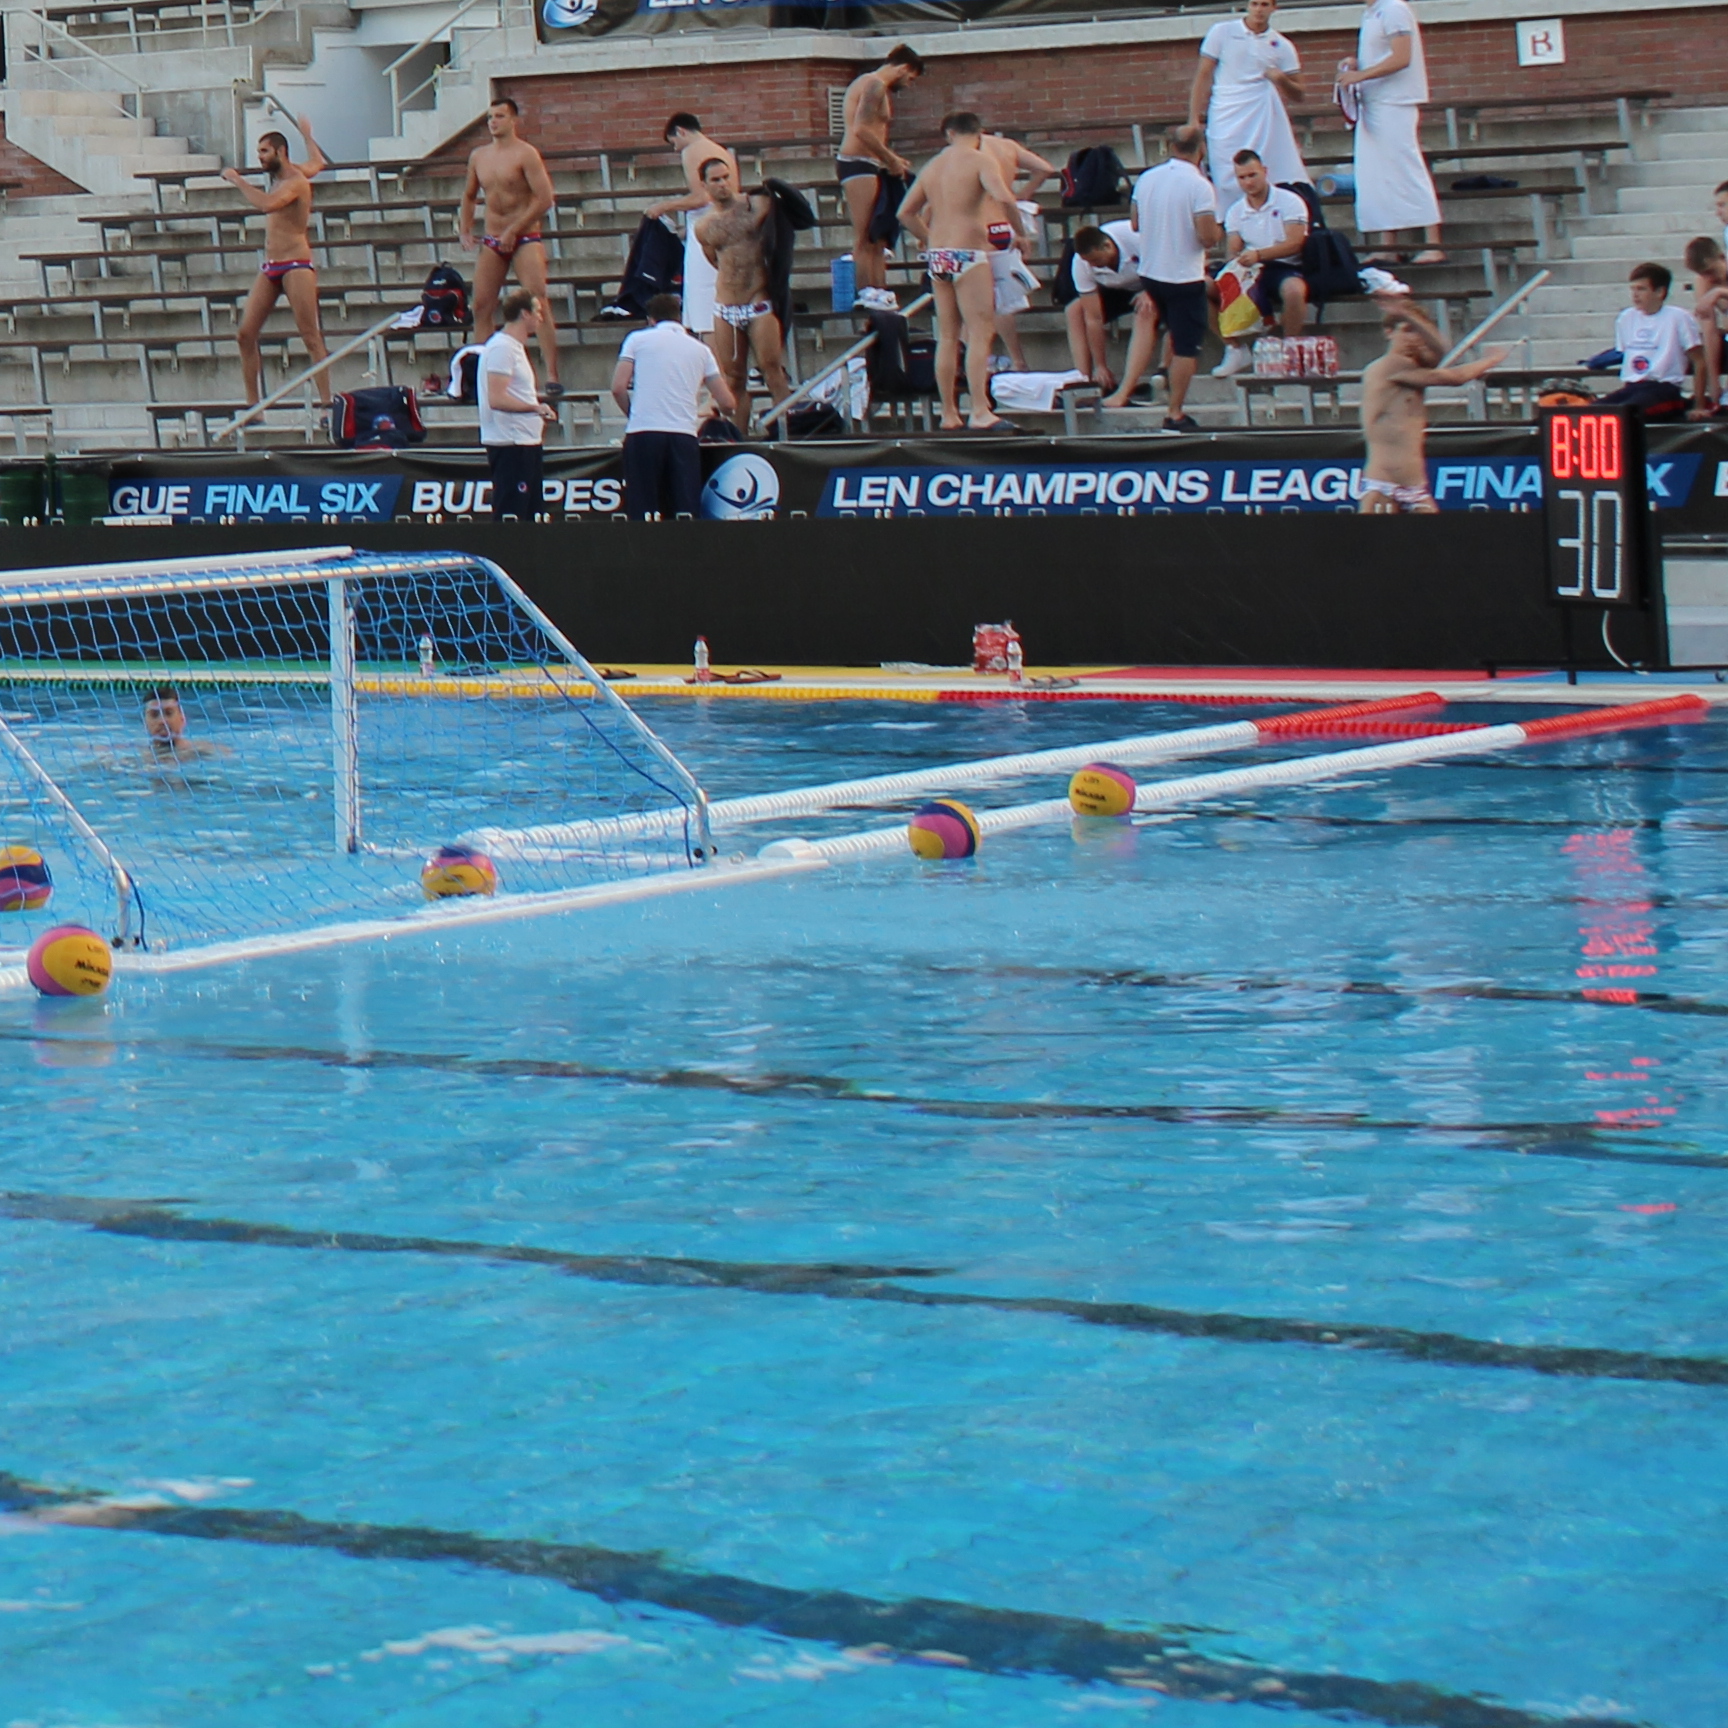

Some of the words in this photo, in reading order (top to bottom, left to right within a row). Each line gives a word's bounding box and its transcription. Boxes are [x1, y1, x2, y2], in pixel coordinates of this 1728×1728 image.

[1552, 415, 1621, 479] 8:00
[112, 485, 191, 515] GUE
[204, 483, 311, 514] FINAL
[319, 482, 381, 514] SIX
[412, 478, 626, 514] BUDPES
[833, 475, 920, 509] LEN
[928, 469, 1209, 506] CHAMPIONS
[1221, 467, 1364, 502] LEAGU
[1435, 465, 1544, 500] FINA
[1558, 489, 1622, 599] 30
